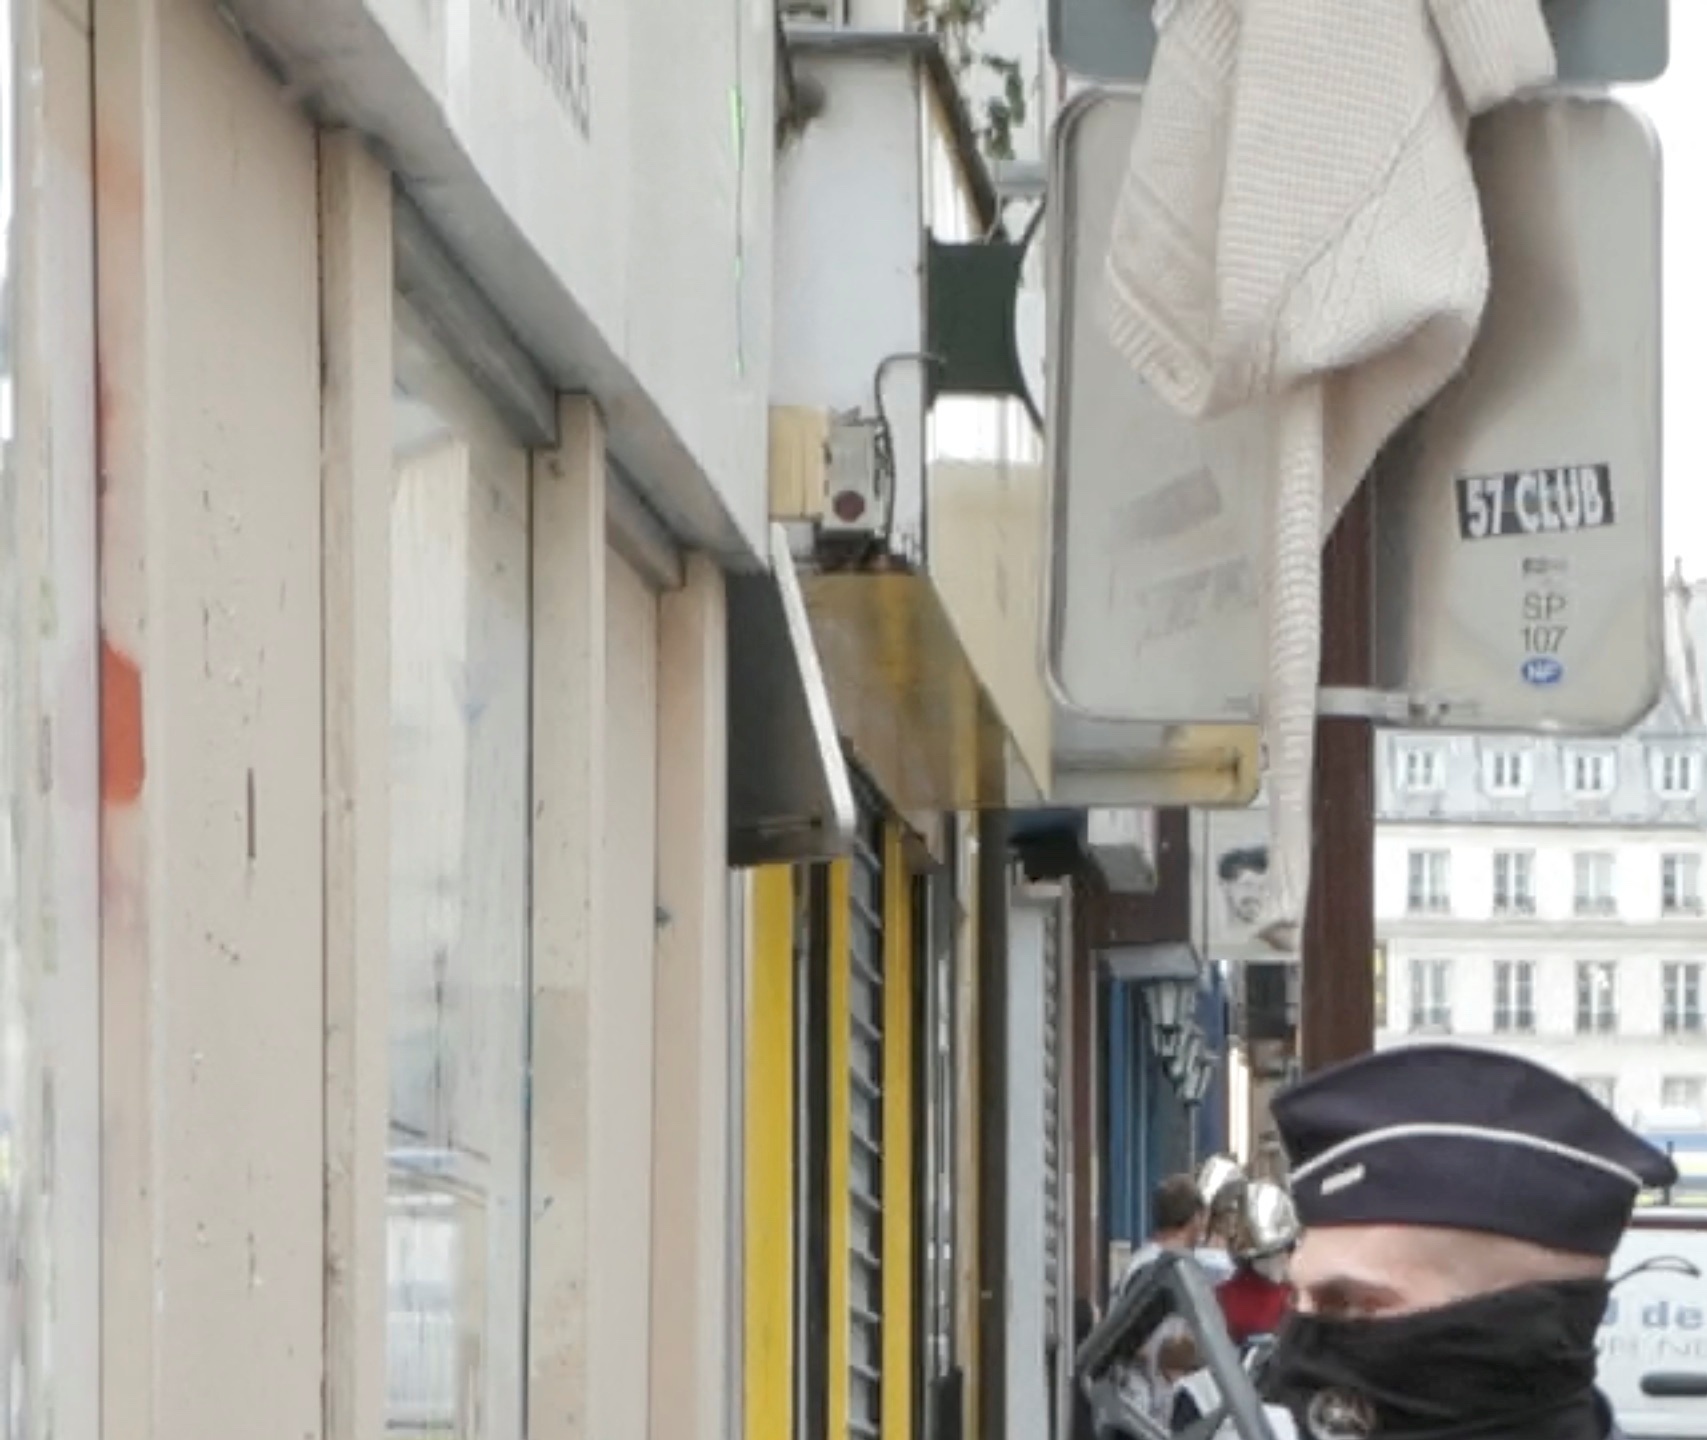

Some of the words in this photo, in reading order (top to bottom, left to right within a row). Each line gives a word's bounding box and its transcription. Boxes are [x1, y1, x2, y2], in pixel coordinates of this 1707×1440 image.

[1465, 478, 1503, 538] 57
[1513, 466, 1605, 534] CLUB
[1523, 590, 1567, 620] SP
[1520, 625, 1569, 654] 107
[1641, 1300, 1704, 1330] de
